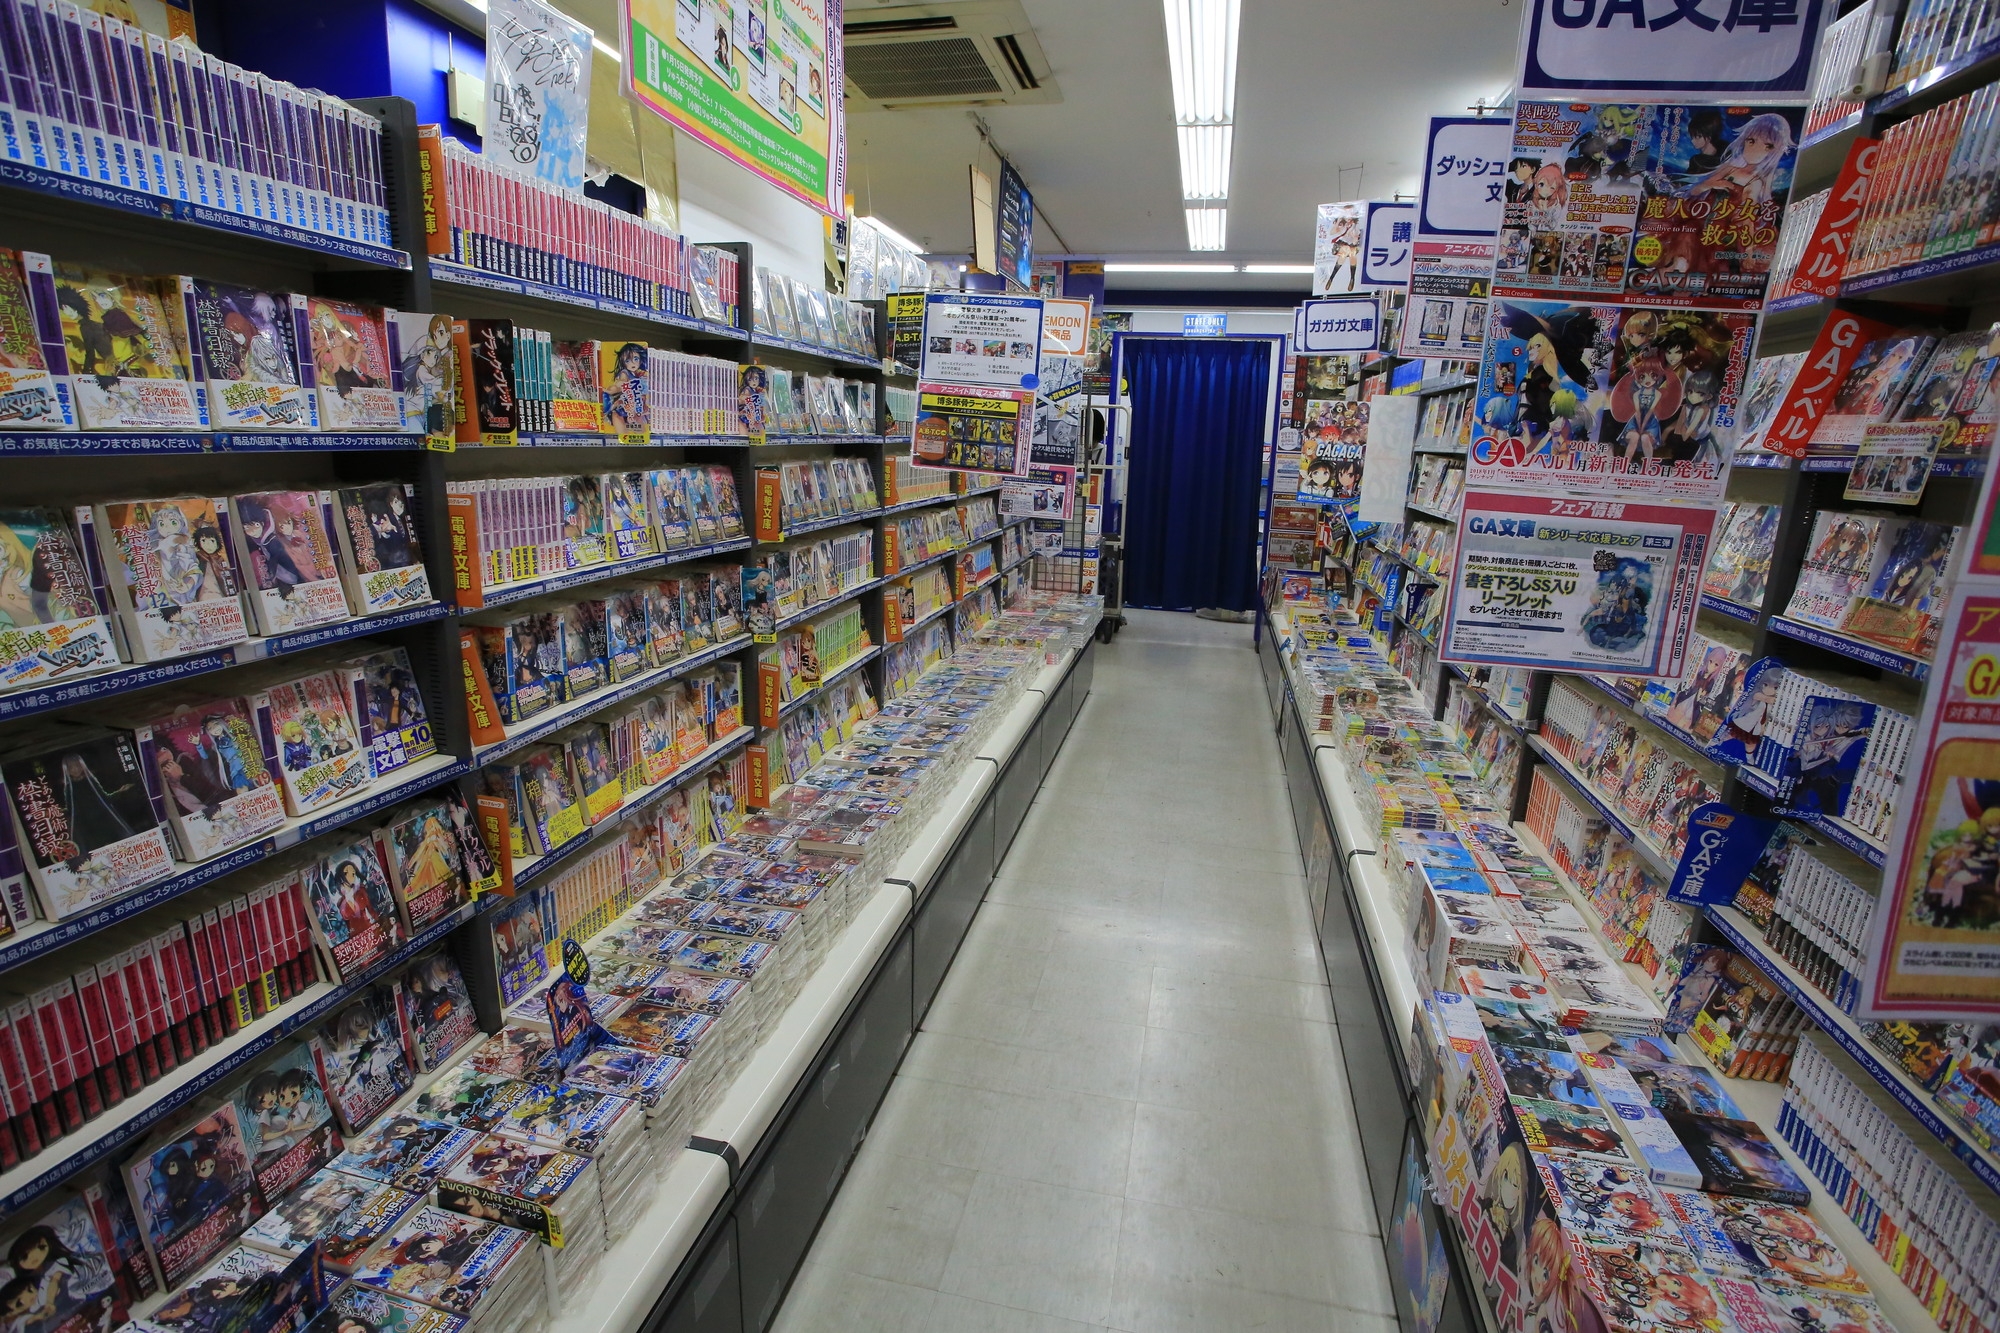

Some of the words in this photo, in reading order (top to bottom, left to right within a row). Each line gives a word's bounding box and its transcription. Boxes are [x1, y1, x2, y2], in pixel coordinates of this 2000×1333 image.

[1516, 119, 1582, 136] テニス無双
[1518, 104, 1560, 121] 異世界
[0, 111, 22, 159] 電撃文庫
[26, 120, 47, 168] 電撃文庫
[52, 126, 72, 172] 電撃文庫
[71, 132, 90, 177] 電撃文庫
[94, 137, 111, 180] 電撃文庫
[114, 143, 131, 187] 電撃文庫
[134, 148, 150, 191] 電撃文庫
[1436, 156, 1506, 178] ダッシュ
[153, 154, 168, 196] 電撃文庫
[175, 160, 188, 200] 電撃文庫
[196, 165, 210, 205] 電撃文庫
[213, 169, 226, 208] 電撃文庫
[1570, 184, 1592, 193] 高2に
[231, 175, 244, 213] 電撃文庫
[250, 179, 262, 216] 電撃文庫
[266, 183, 278, 220] 電撃文庫
[282, 188, 293, 224] 電撃文庫
[296, 191, 307, 227] 電撃文庫
[1484, 182, 1503, 204] 文
[1567, 203, 1637, 215] 当時好きだった先生に
[1569, 193, 1638, 205] タイムリープした俺が、
[1642, 197, 1779, 223] 魔人の少女を
[310, 196, 320, 230] 電撃文庫
[323, 197, 333, 231] 電撃文庫
[335, 203, 345, 237] 電撃文庫
[347, 206, 357, 239] 電撃文庫
[1640, 224, 1671, 232] Goodbye
[1681, 225, 1697, 233] Fate
[1807, 145, 1878, 279] GAノベル
[195, 207, 398, 264] 商品が店頭に無い場合、お気軽にスタッフまでお尋ねください。
[1635, 247, 1661, 257] 優秀賞
[1700, 224, 1776, 247] 救うもの
[1370, 248, 1408, 267] ラノ
[1415, 264, 1492, 276] メルヘン・メドヘン
[1628, 268, 1707, 293] GA文庫
[1710, 287, 1761, 296] 1月15日(月)発売
[1185, 317, 1207, 326] STAFF
[1207, 317, 1225, 326] ONLY
[1309, 318, 1374, 333] ガガガ文庫
[481, 327, 511, 411] ブラック・ブレット
[1779, 318, 1860, 440] GAノベル
[56, 383, 74, 425] 電撃文庫
[196, 388, 209, 425] 電撃文庫
[308, 394, 318, 427] 電撃文庫
[398, 397, 406, 427] 電撃文庫
[937, 397, 1003, 409] 博多豚骨ラーメンズ
[232, 436, 418, 448] 商品が店頭に無い場合、お気軽にスタッフまでお尋ねください。
[1570, 442, 1608, 453] 2018年
[1565, 452, 1726, 481] 1月新刊は15日発売!
[763, 485, 773, 530] 電撃文庫
[1549, 500, 1626, 519] フェア情報
[637, 531, 648, 543] 10
[1469, 517, 1536, 540] GA文庫
[1538, 528, 1642, 546] 新シリーズ応援フェア
[1645, 537, 1671, 548] 第三弾
[450, 515, 472, 590] 電撃文庫
[620, 544, 636, 557] 文庫
[1680, 533, 1694, 566] 開催場所
[1691, 533, 1706, 567] 開催期間
[1465, 572, 1577, 595] 書き下ろしSS入り
[1482, 590, 1553, 609] リーフレット
[1672, 567, 1687, 611] 全国アニメイト
[281, 606, 448, 650] 商品が店頭に無い場合、お気軽にスタッフまでお尋ねください。
[1965, 605, 2000, 637] ア
[1775, 620, 1903, 671] 商品が店頭に無い場合、お気軽にスタッフまでお尋ねください。
[463, 659, 491, 729] 電撃文庫
[1968, 657, 2000, 697] G
[763, 675, 773, 718] 電撃文庫
[373, 735, 401, 752] 電撃
[412, 725, 432, 743] 10
[376, 751, 408, 772] 文庫
[752, 756, 763, 798] 電撃文庫
[313, 762, 468, 832] 商品が店頭に無い場合、お気軽にスタッフまでお尋ねください。
[1679, 829, 1722, 899] GA文庫
[8, 882, 28, 922] 電撃文庫
[14, 1037, 272, 1206] 商品が店頭に無い場合、お気軽にスタッフまでお尋ねください。
[440, 1178, 480, 1198] SWORD
